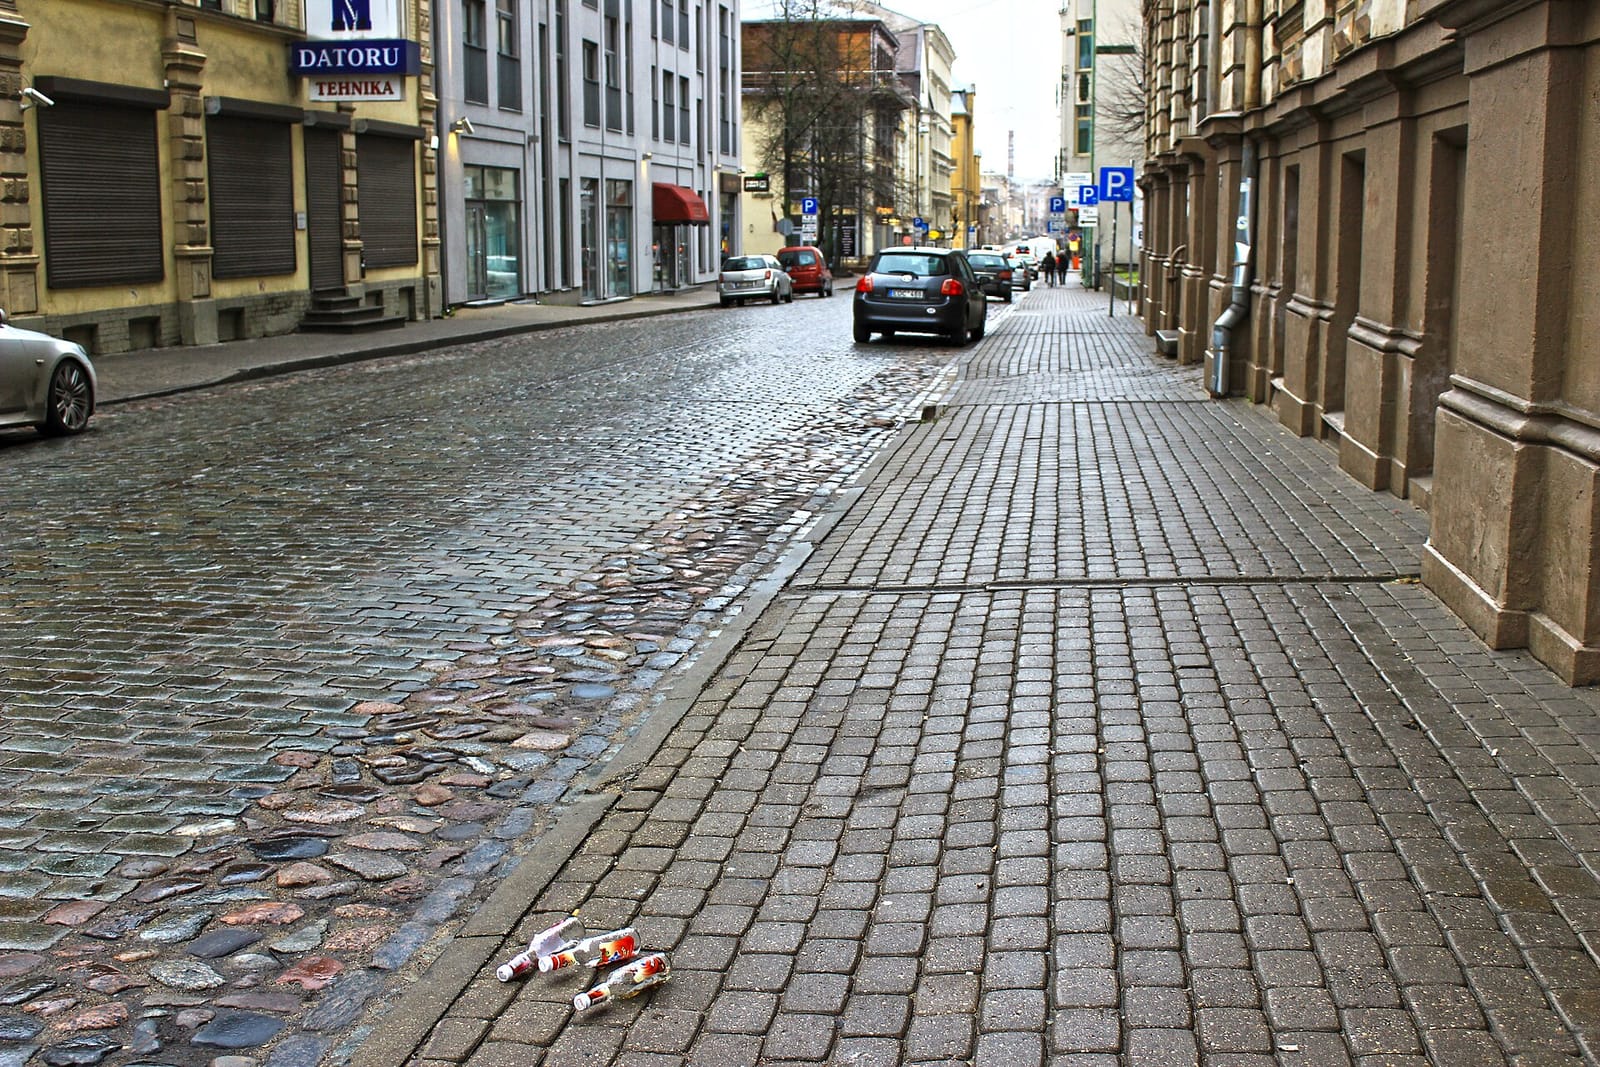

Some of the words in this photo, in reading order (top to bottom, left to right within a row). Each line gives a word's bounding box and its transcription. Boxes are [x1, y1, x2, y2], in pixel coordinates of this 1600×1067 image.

[298, 47, 399, 68] DATORU
[315, 80, 395, 97] TEHNIKA
[1106, 171, 1126, 198] P
[1082, 187, 1094, 203] P
[804, 199, 814, 212] P
[1053, 199, 1062, 211] P
